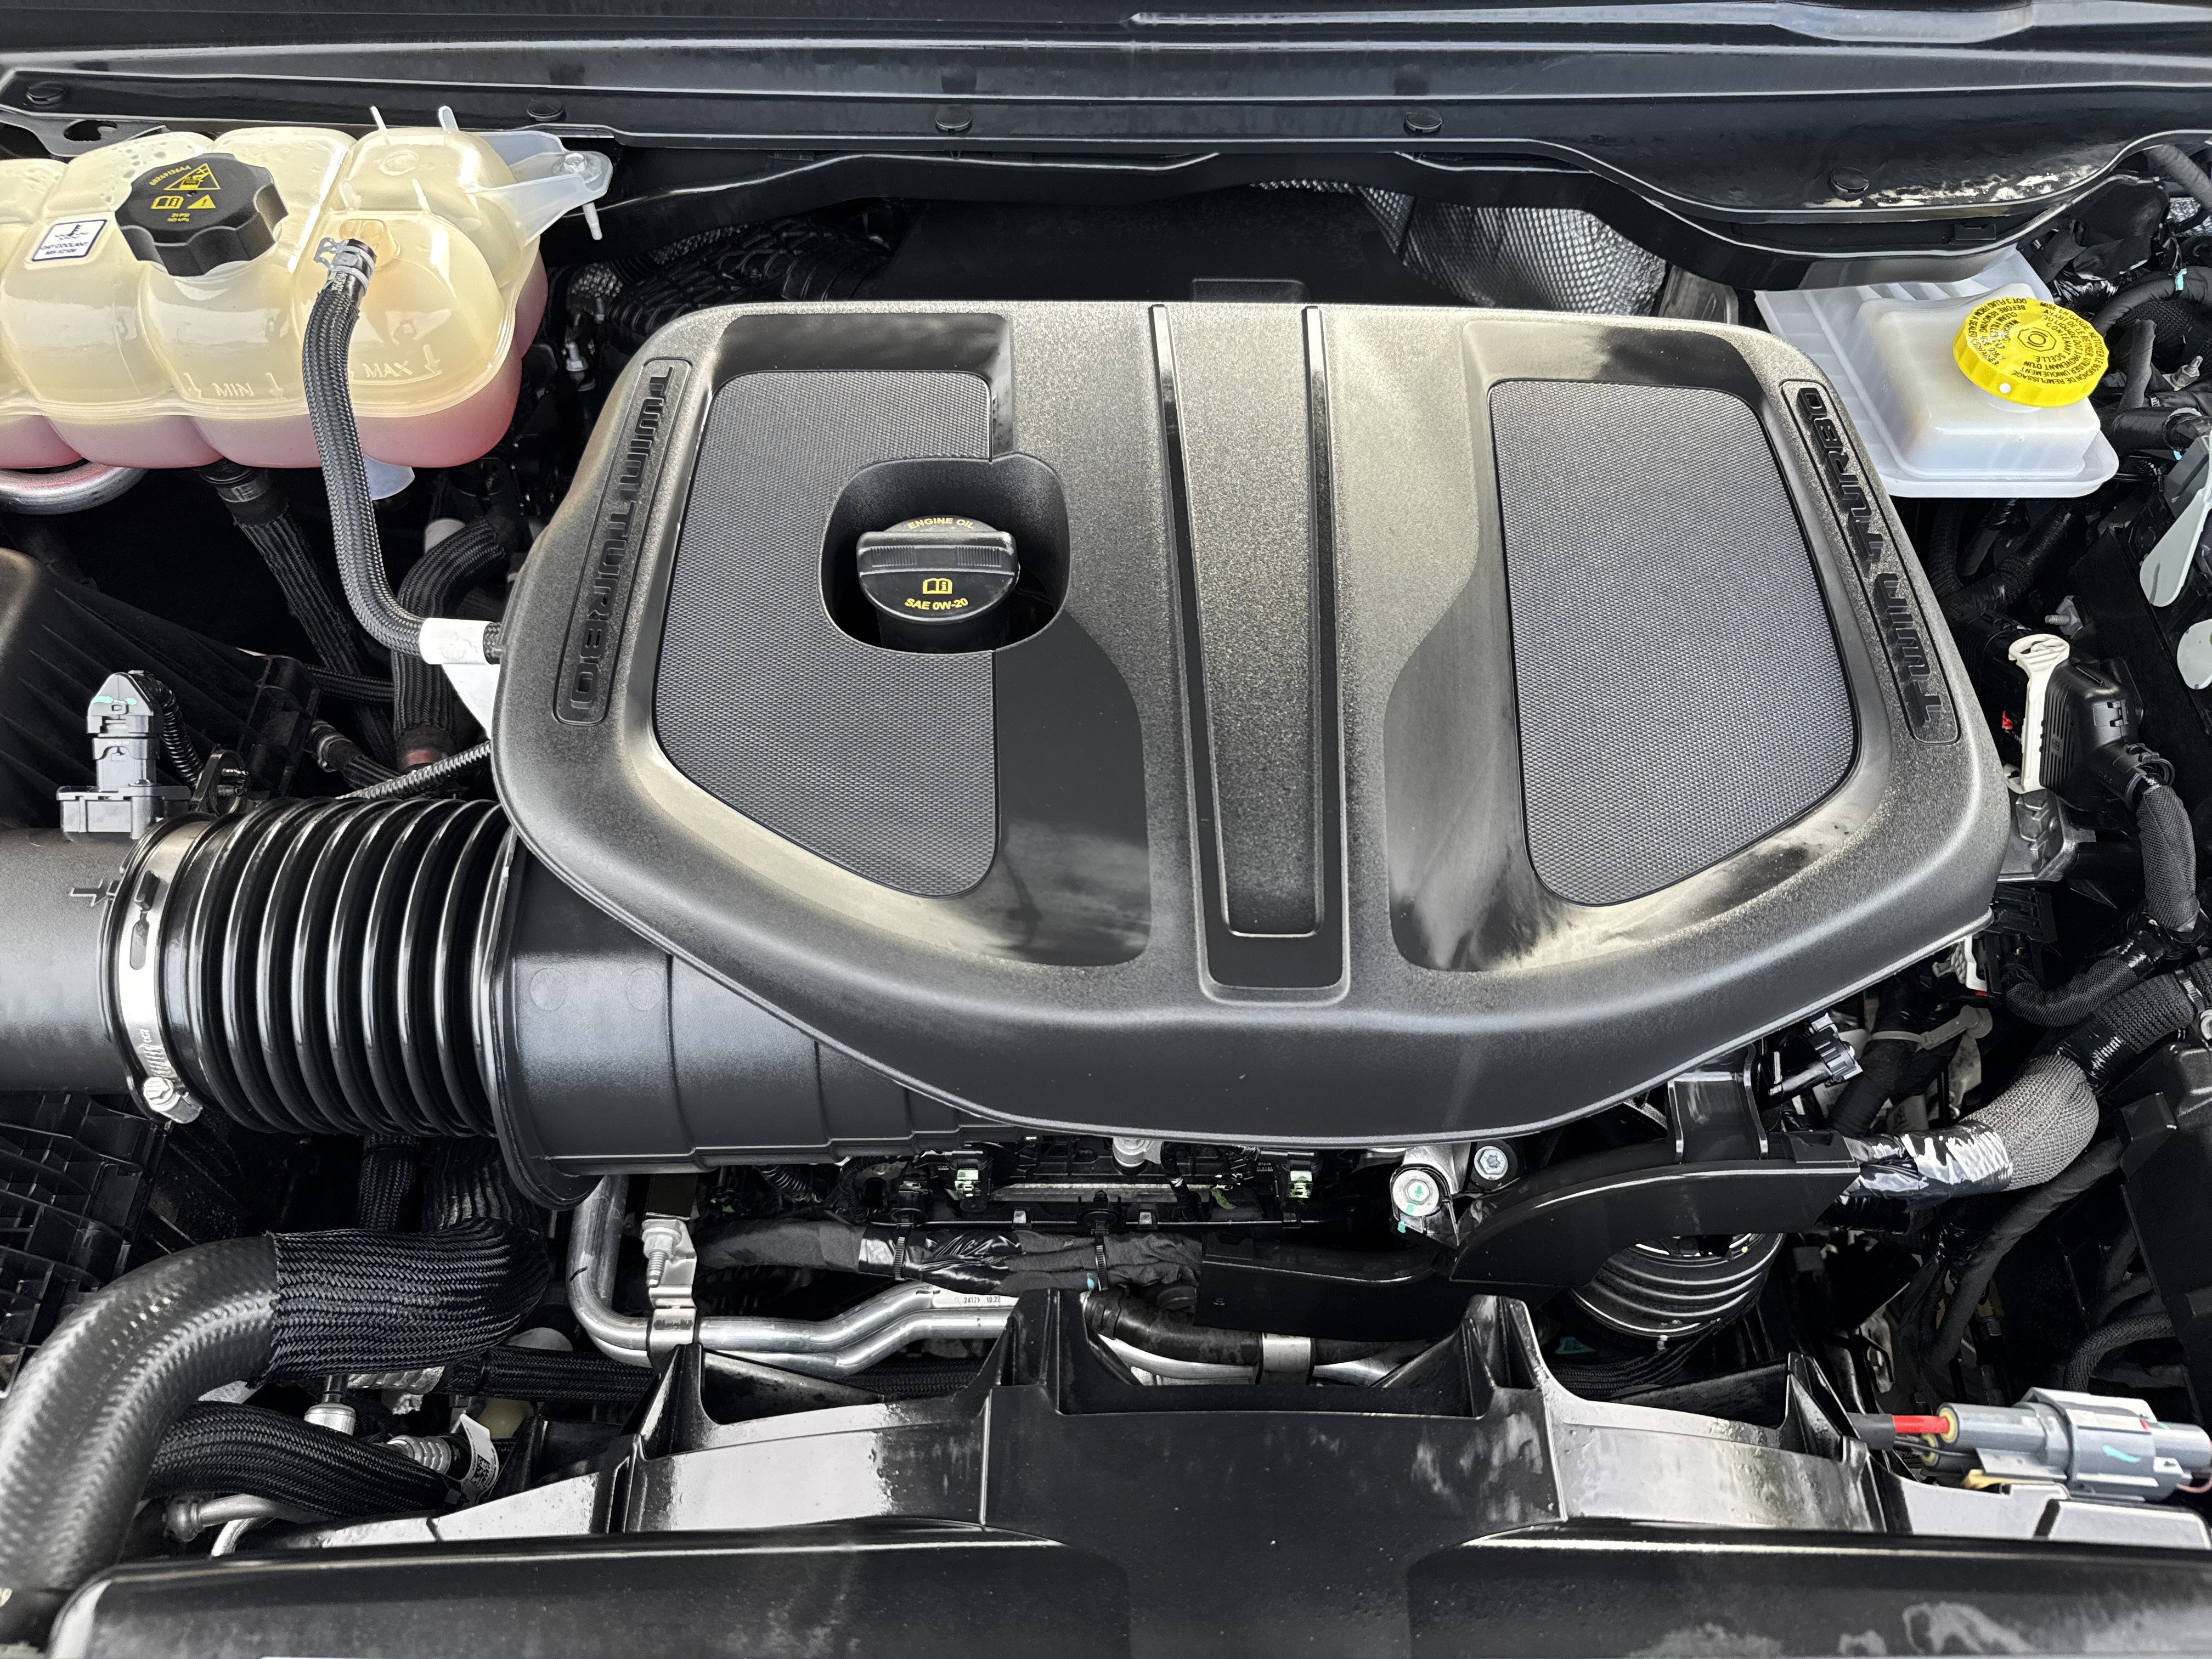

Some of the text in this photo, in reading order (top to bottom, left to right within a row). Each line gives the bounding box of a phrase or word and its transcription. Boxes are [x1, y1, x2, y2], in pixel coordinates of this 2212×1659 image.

[1987, 299, 2006, 308] FLUID
[1997, 305, 2026, 313] BEFORE
[2040, 302, 2057, 311] MISE
[1974, 305, 1990, 317] FROM
[1996, 312, 2018, 323] CLEAN
[2043, 309, 2069, 321] AVANT
[1968, 319, 1978, 338] SEALED
[2054, 320, 2080, 340] LIQUIDE
[2066, 320, 2079, 329] DE
[2046, 322, 2073, 356] CONTENANT
[2073, 340, 2084, 352] DOT
[2087, 332, 2105, 358] NETTOYER
[2023, 360, 2043, 370] D'UN
[2045, 353, 2082, 370] PROVENANT
[2068, 357, 2092, 374] UTILISER
[361, 360, 414, 379] MAX
[2020, 366, 2072, 377] UNIQUEMENT
[2074, 363, 2102, 382] BOUCHON
[2011, 370, 2066, 385] REMPLISSAGE
[211, 381, 255, 397] MIN
[907, 517, 974, 530] ENGINE OIL
[572, 366, 674, 710] TWIN TURBO
[1797, 387, 1942, 729] TURBO TWIN
[905, 597, 969, 611] SAE 0W-20
